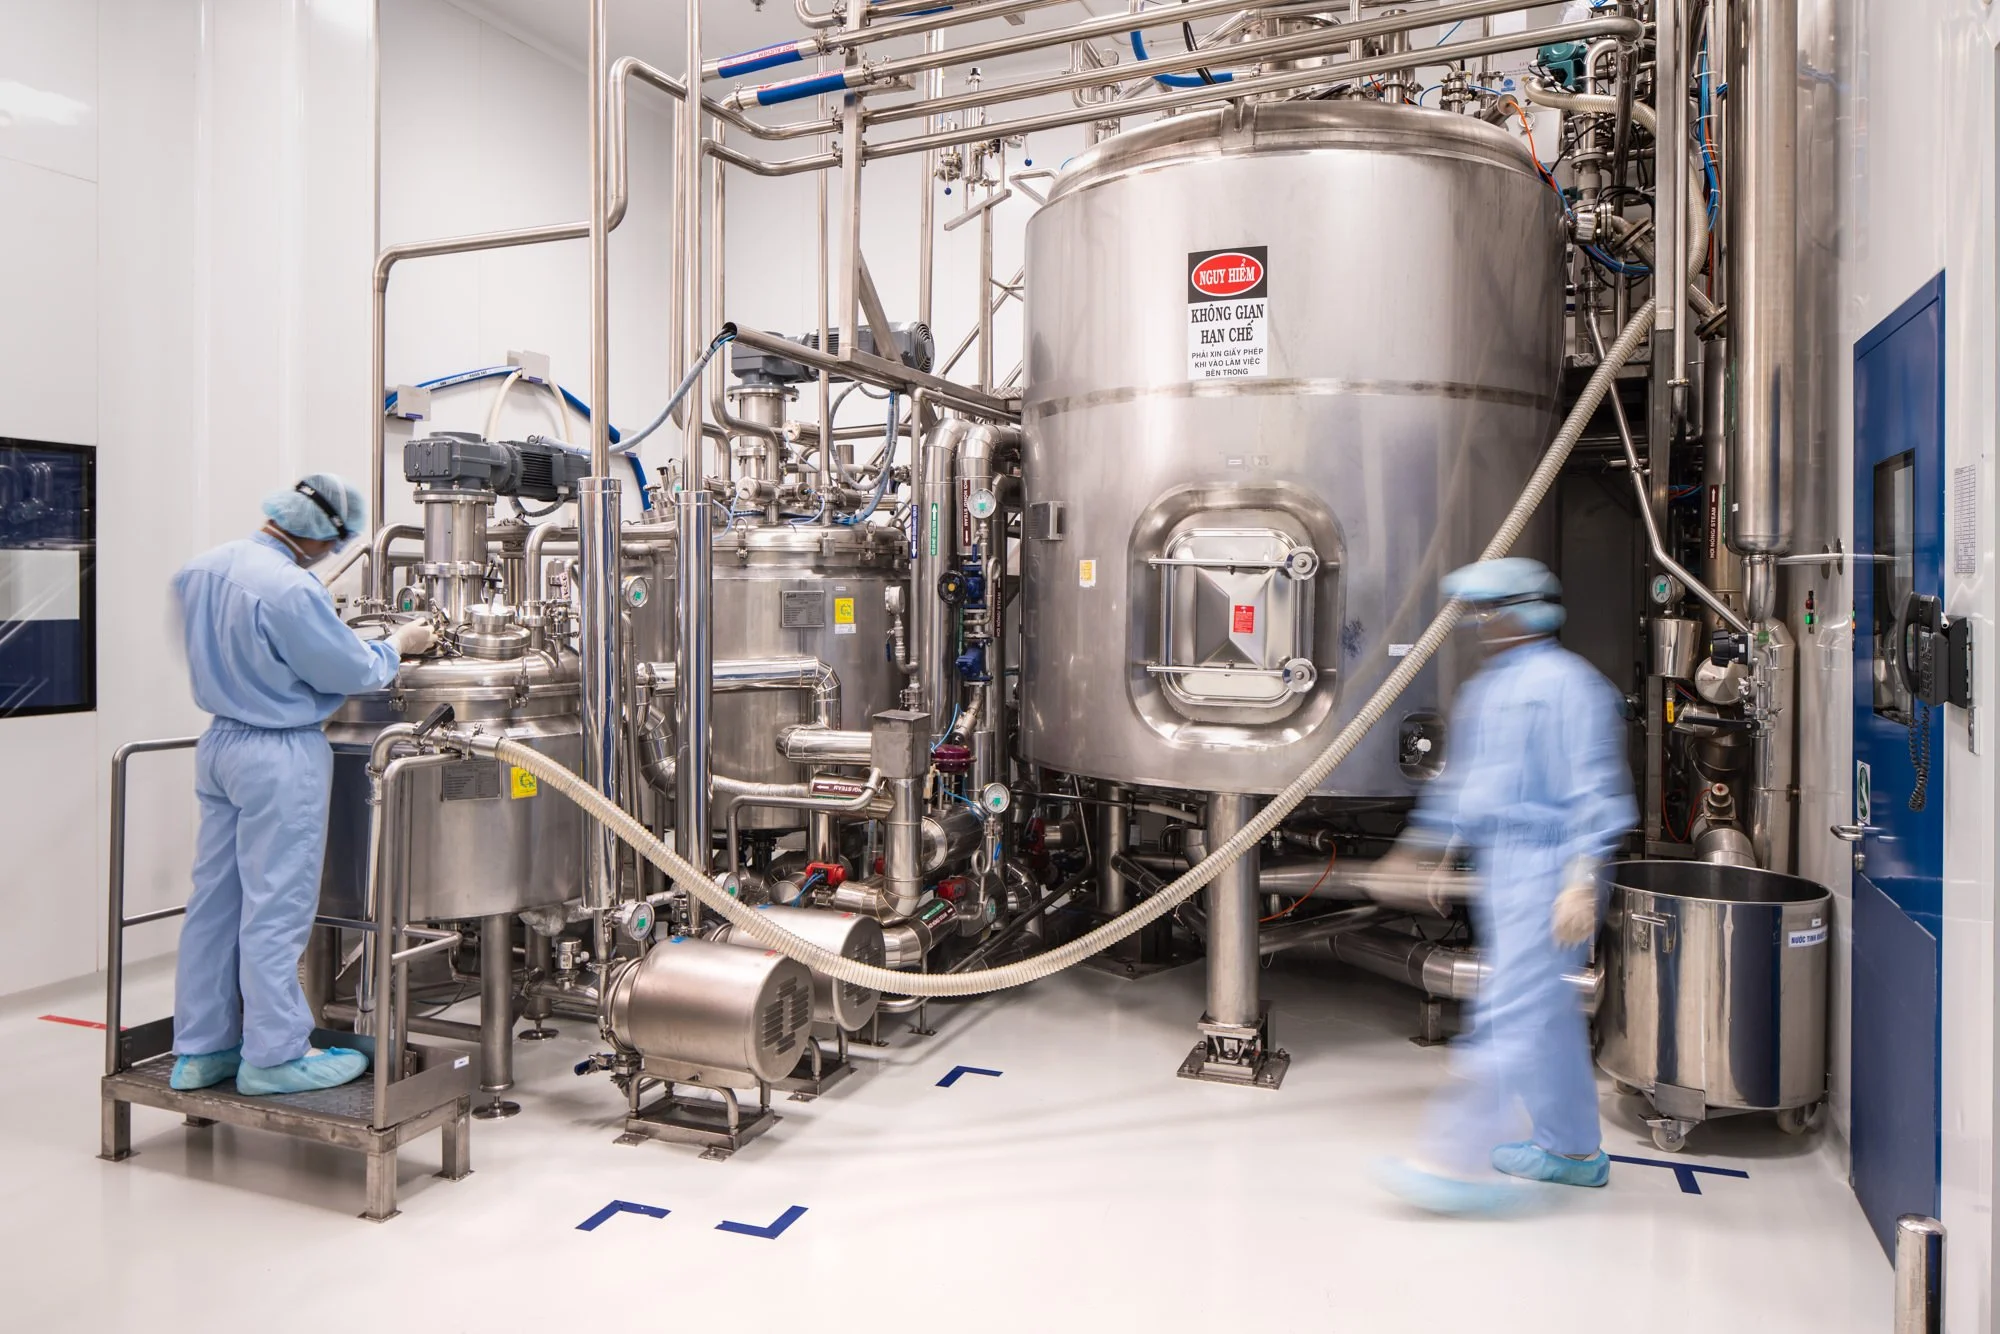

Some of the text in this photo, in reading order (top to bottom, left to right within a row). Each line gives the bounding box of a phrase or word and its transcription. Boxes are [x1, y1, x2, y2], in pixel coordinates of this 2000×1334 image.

[1199, 258, 1255, 285] NGUY HIỂM
[1191, 304, 1264, 323] KHÔNG GIAN
[1201, 319, 1253, 347] HẠN CHẾ
[1243, 347, 1264, 356] PHÉP
[1194, 361, 1207, 369] KHI
[1208, 359, 1223, 368] VÀO
[1225, 358, 1241, 367] LÀM
[1206, 368, 1249, 377] BÊN TRONG
[833, 785, 852, 793] STEAM
